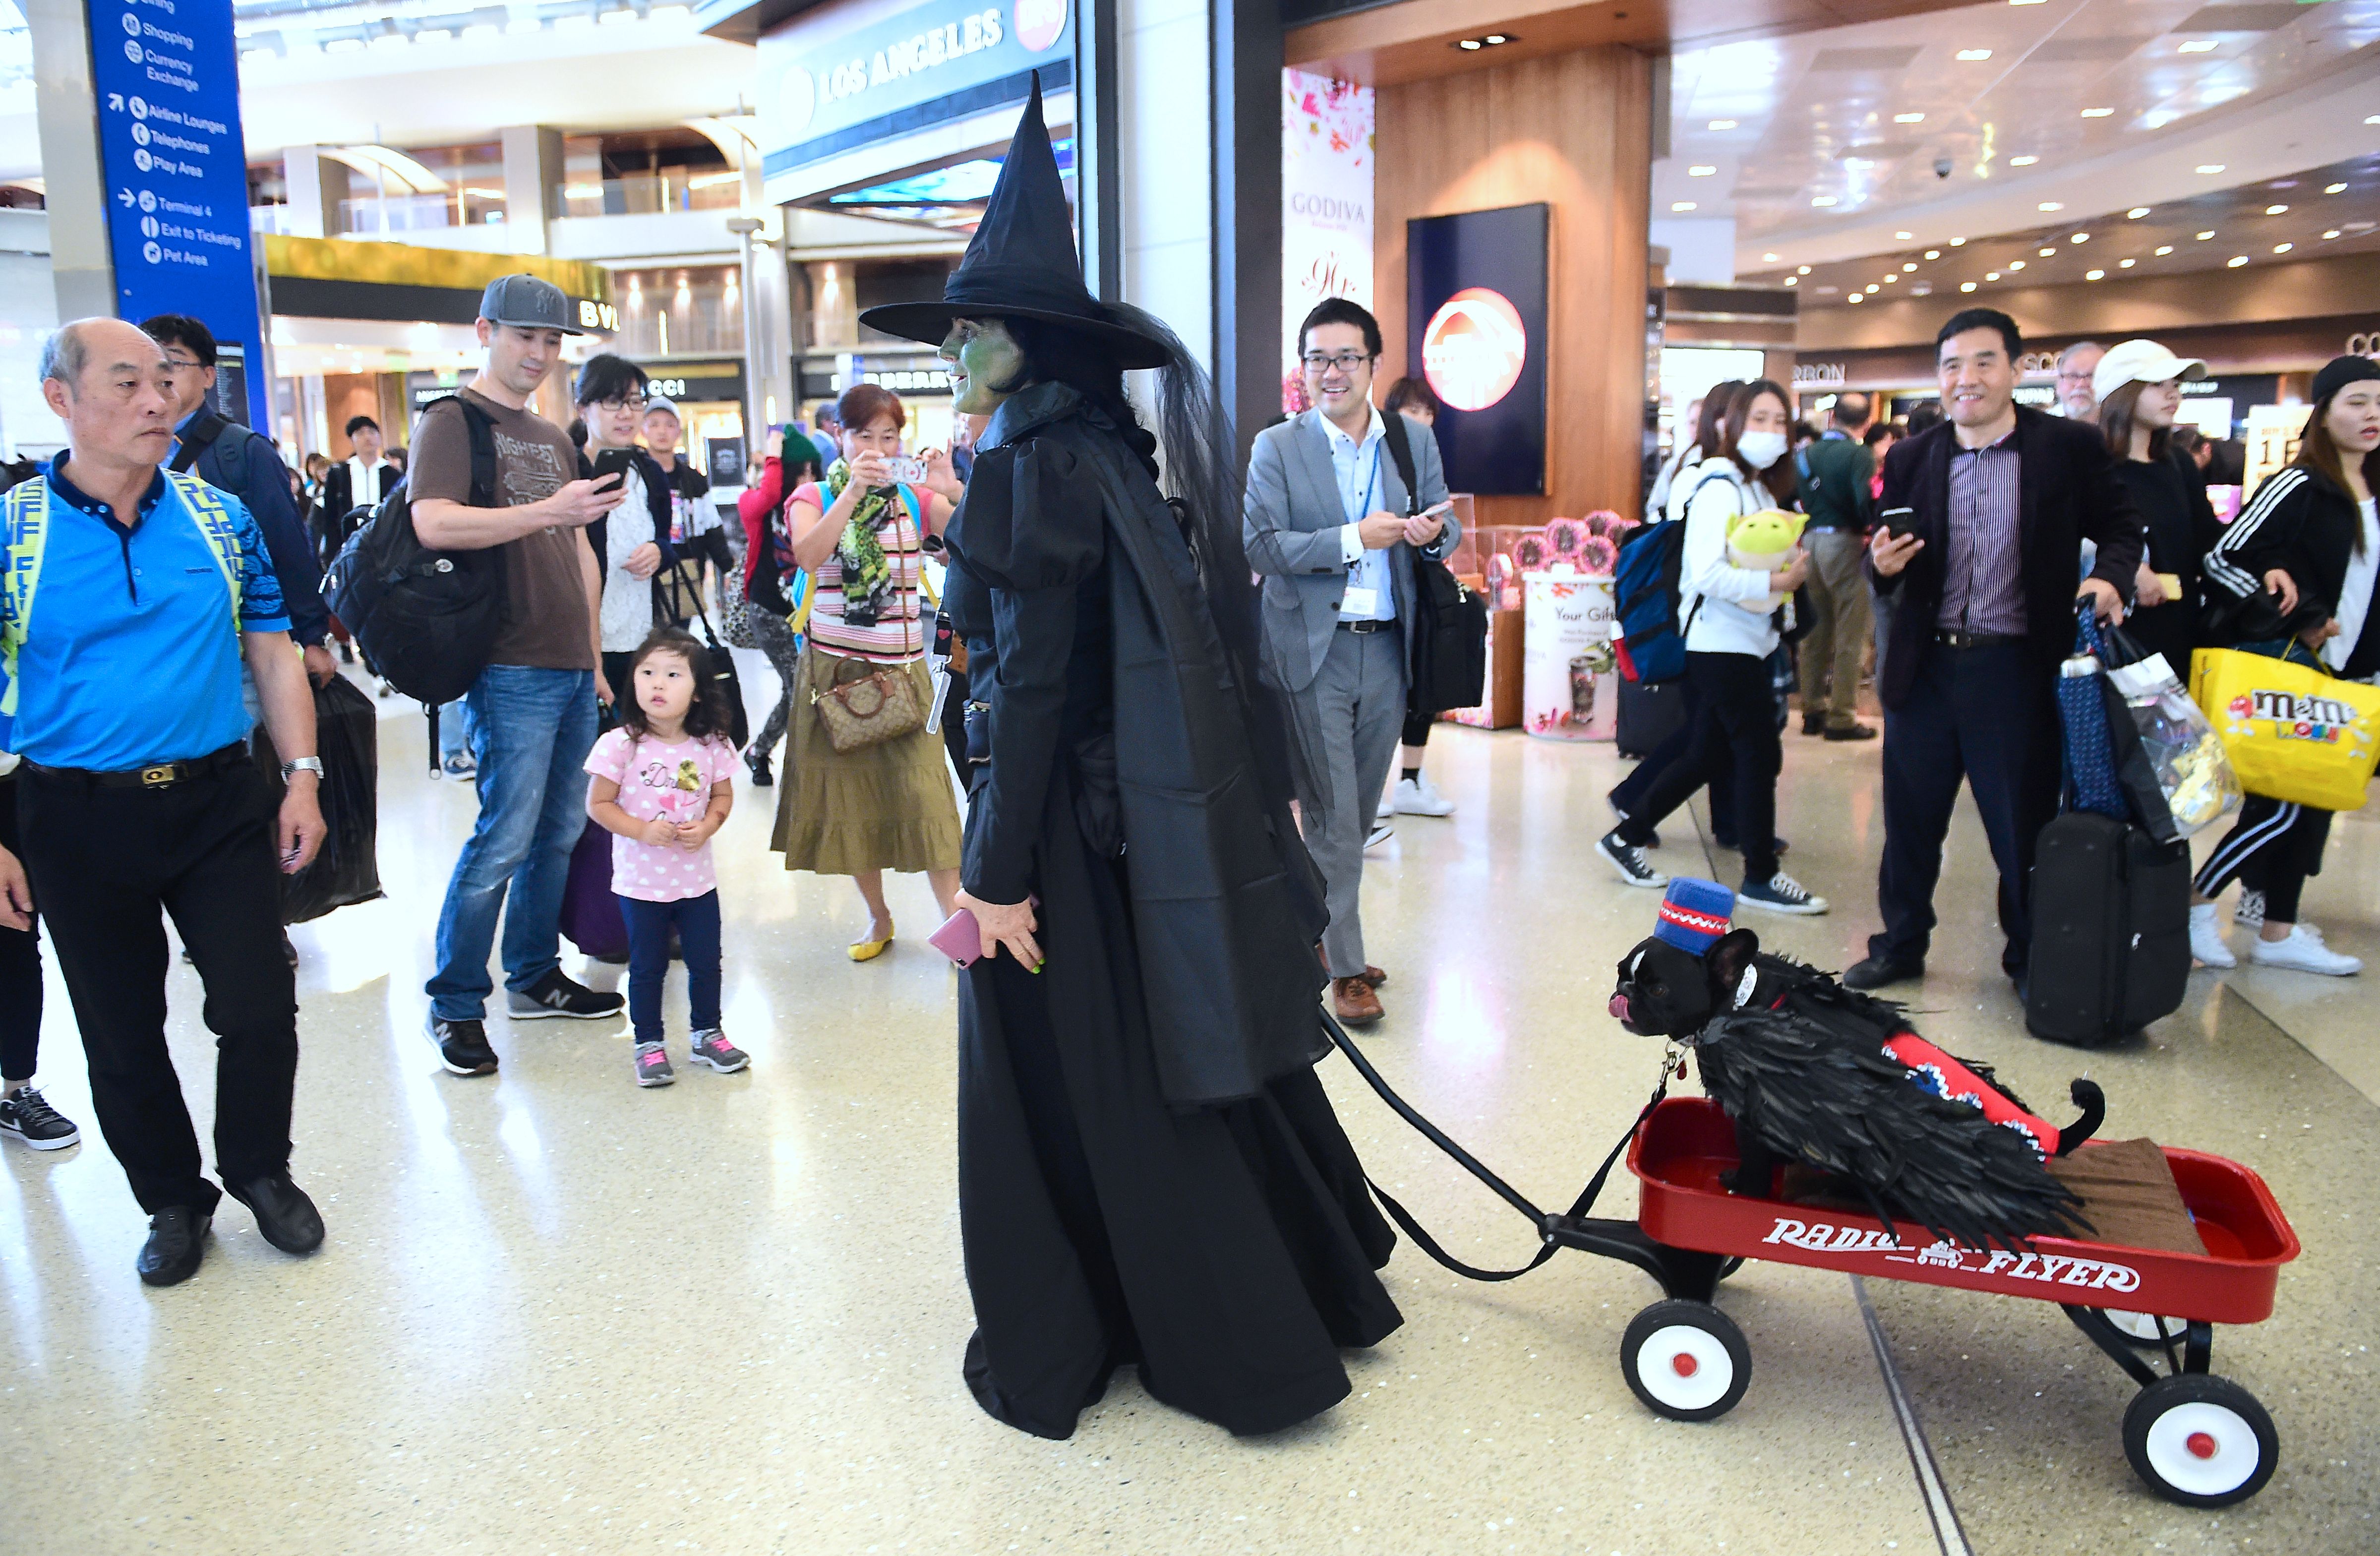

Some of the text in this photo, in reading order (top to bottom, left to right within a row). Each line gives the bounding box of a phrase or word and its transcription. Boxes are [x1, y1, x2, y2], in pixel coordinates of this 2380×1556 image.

[143, 22, 194, 51] Shopping
[145, 49, 193, 76] Currency
[819, 7, 1003, 104] LOS ANGELES
[147, 65, 199, 93] Exchange
[149, 104, 228, 135] Airline Lounges
[150, 129, 211, 155] Telephones
[153, 155, 203, 178] Play Area
[158, 197, 212, 218] Terminal 4
[1291, 192, 1365, 223] GODIVA
[161, 222, 242, 250] Exit to Ticketing
[163, 247, 209, 267] Pet Area
[1555, 606, 1582, 620] Your
[544, 988, 572, 1008] N
[1762, 1217, 2140, 1293] RADIO FLYER
